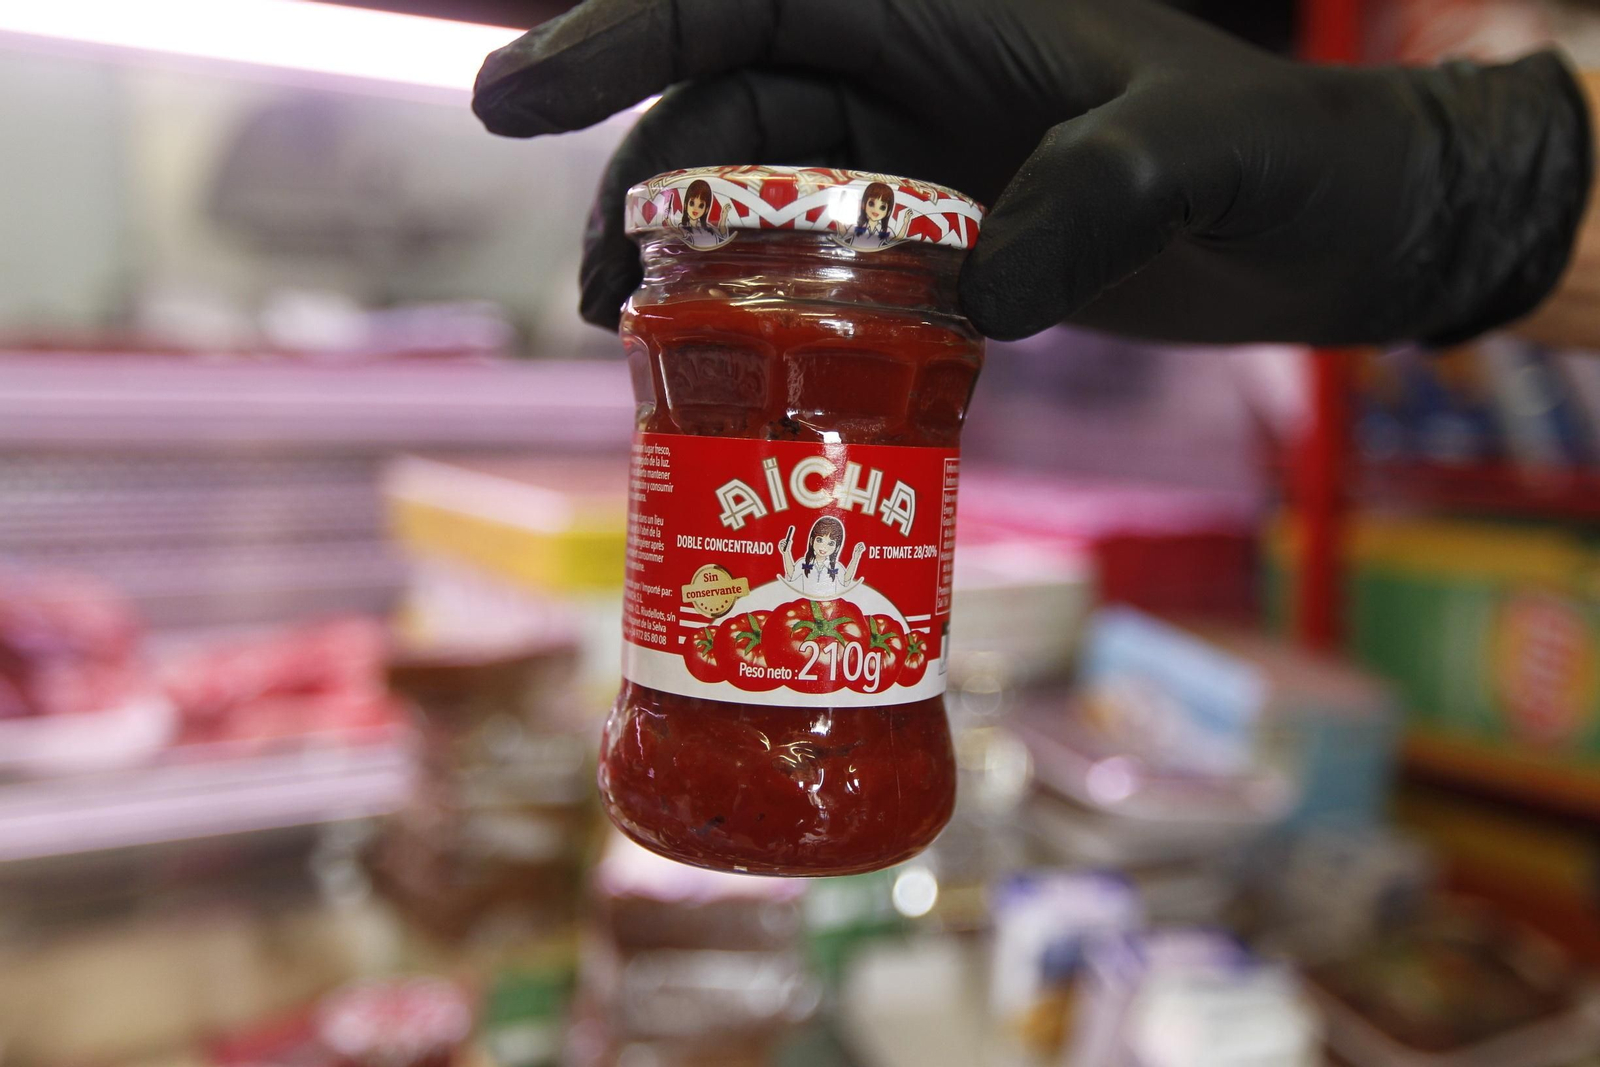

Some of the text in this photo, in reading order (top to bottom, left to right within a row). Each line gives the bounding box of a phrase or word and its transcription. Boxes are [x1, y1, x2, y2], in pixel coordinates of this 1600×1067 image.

[676, 534, 774, 556] DOBLE CONCENTRADO
[869, 546, 881, 559] DE
[882, 546, 913, 559] TOMATE
[913, 545, 938, 560] 28/30%
[703, 572, 719, 584] Sin
[686, 585, 742, 600] conservante
[739, 662, 765, 679] Peso
